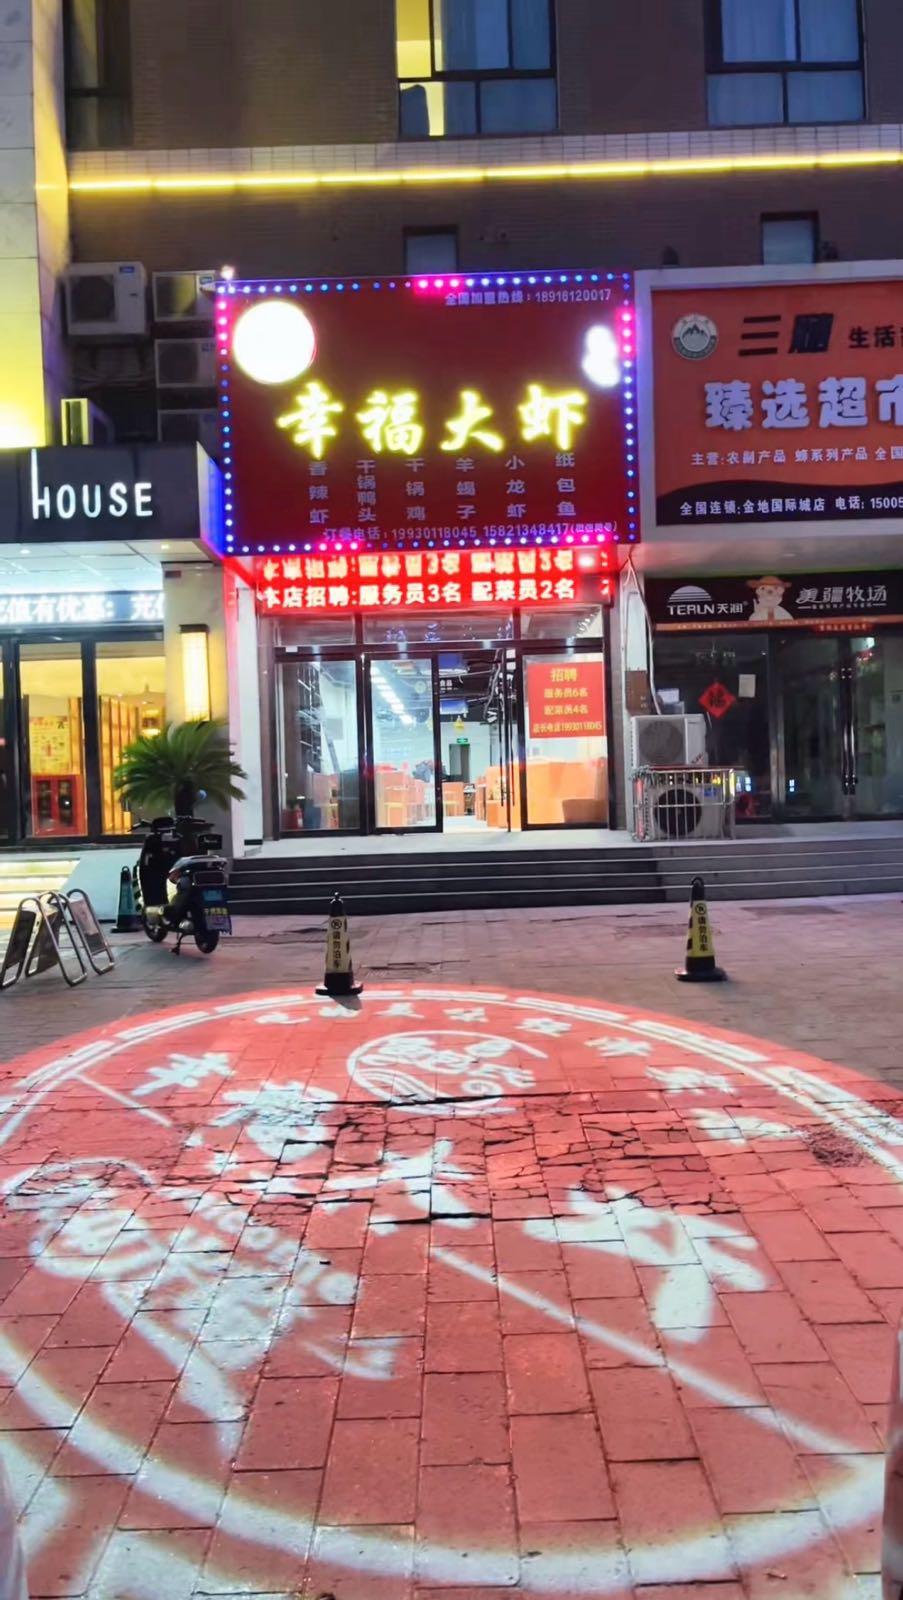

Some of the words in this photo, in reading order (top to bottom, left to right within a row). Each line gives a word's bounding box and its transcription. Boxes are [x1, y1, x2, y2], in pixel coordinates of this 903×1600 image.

[848, 325, 903, 349] 生活
[277, 381, 588, 459] 幸福大虾
[405, 458, 426, 521] 干锅鸡
[505, 455, 526, 519] 小龙虾
[555, 452, 577, 516] 纸包鱼
[471, 578, 575, 602] 配菜员2名
